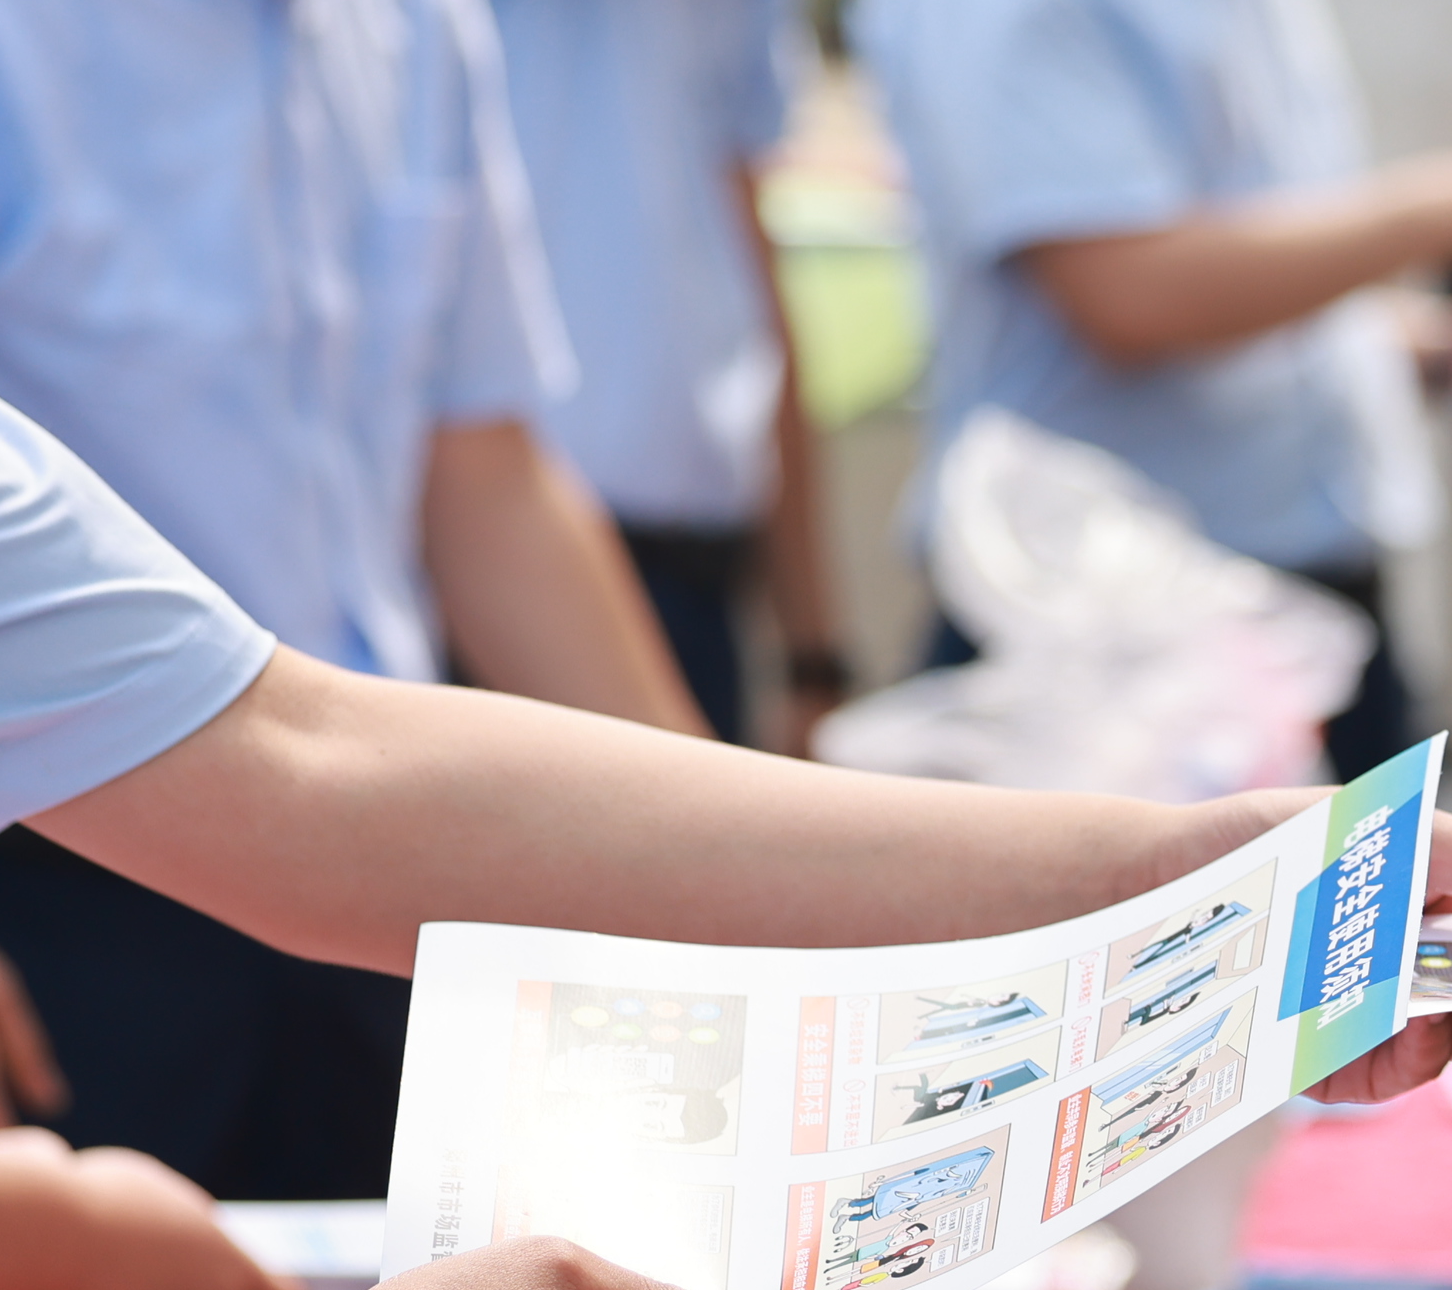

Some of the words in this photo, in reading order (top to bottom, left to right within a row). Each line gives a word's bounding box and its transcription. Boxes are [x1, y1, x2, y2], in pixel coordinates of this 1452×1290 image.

[1316, 804, 1394, 1031] 电梯安全使用须知
[798, 1023, 829, 1128] 安全乘梯四不要
